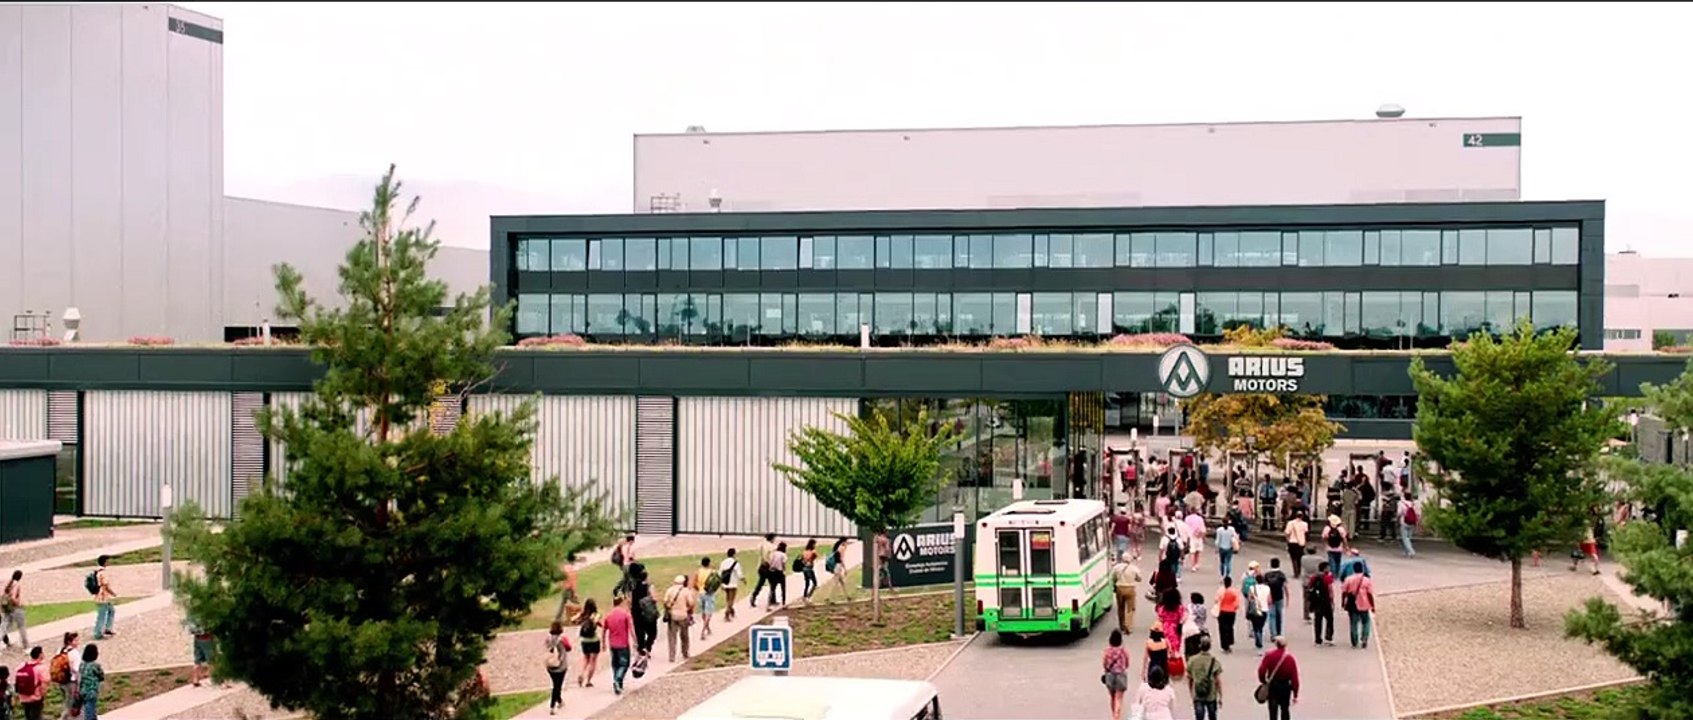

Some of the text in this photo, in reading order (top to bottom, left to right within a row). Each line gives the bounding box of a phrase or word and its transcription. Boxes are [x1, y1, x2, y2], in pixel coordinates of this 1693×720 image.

[1468, 134, 1484, 146] 42
[1228, 357, 1305, 376] ARIUS
[1234, 378, 1298, 392] MOTORS
[920, 546, 956, 556] MOTORS
